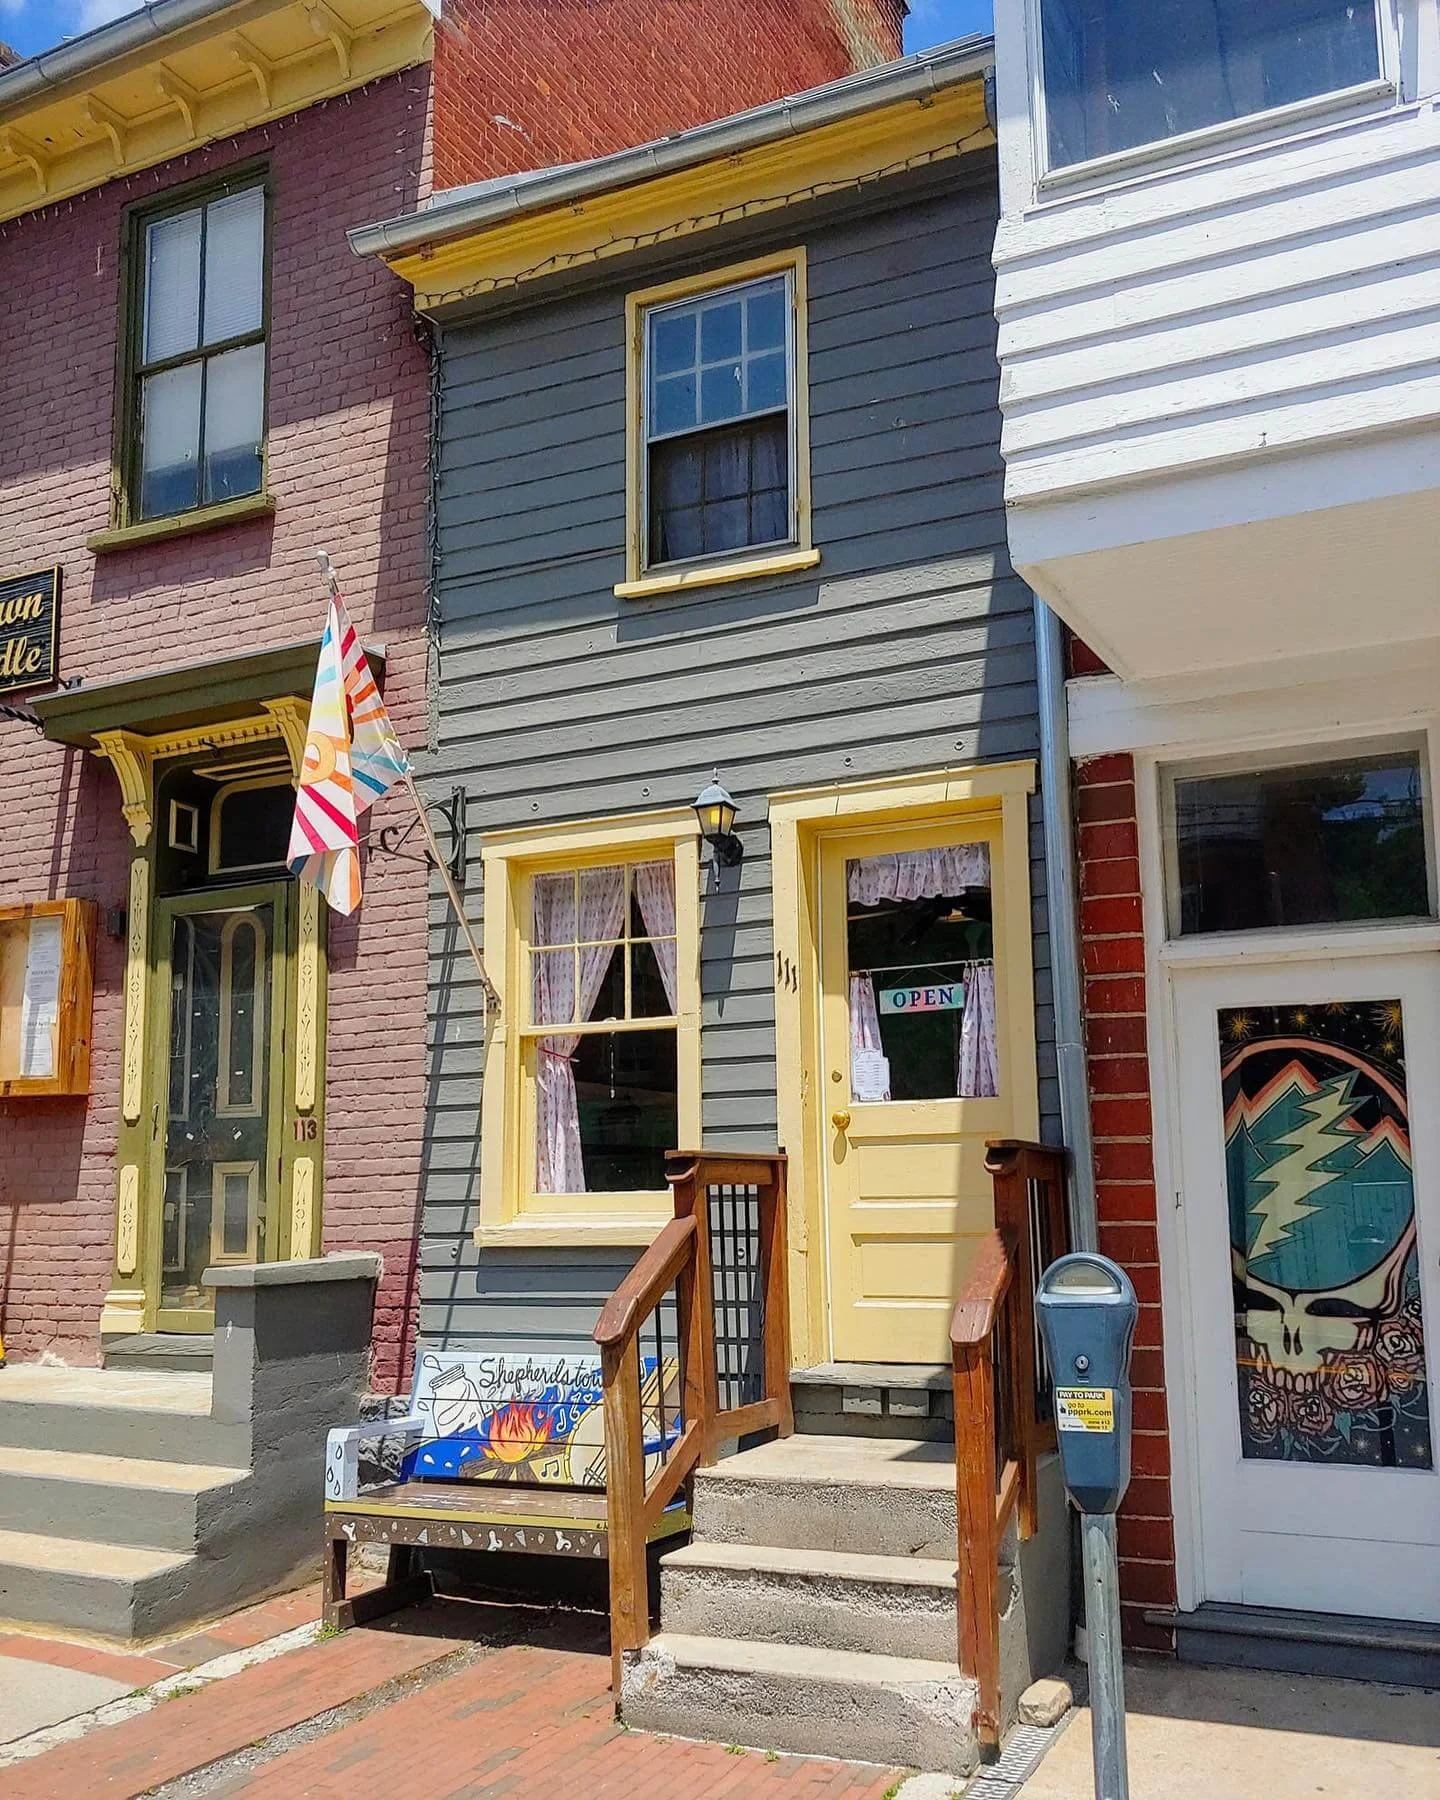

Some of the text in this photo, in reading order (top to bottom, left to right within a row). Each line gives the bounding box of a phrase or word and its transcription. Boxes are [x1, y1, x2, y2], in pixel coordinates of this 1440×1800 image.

[892, 986, 955, 1008] OPEN
[293, 1119, 317, 1142] 113
[1073, 1391, 1083, 1399] TO
[1084, 1391, 1104, 1399] PARK
